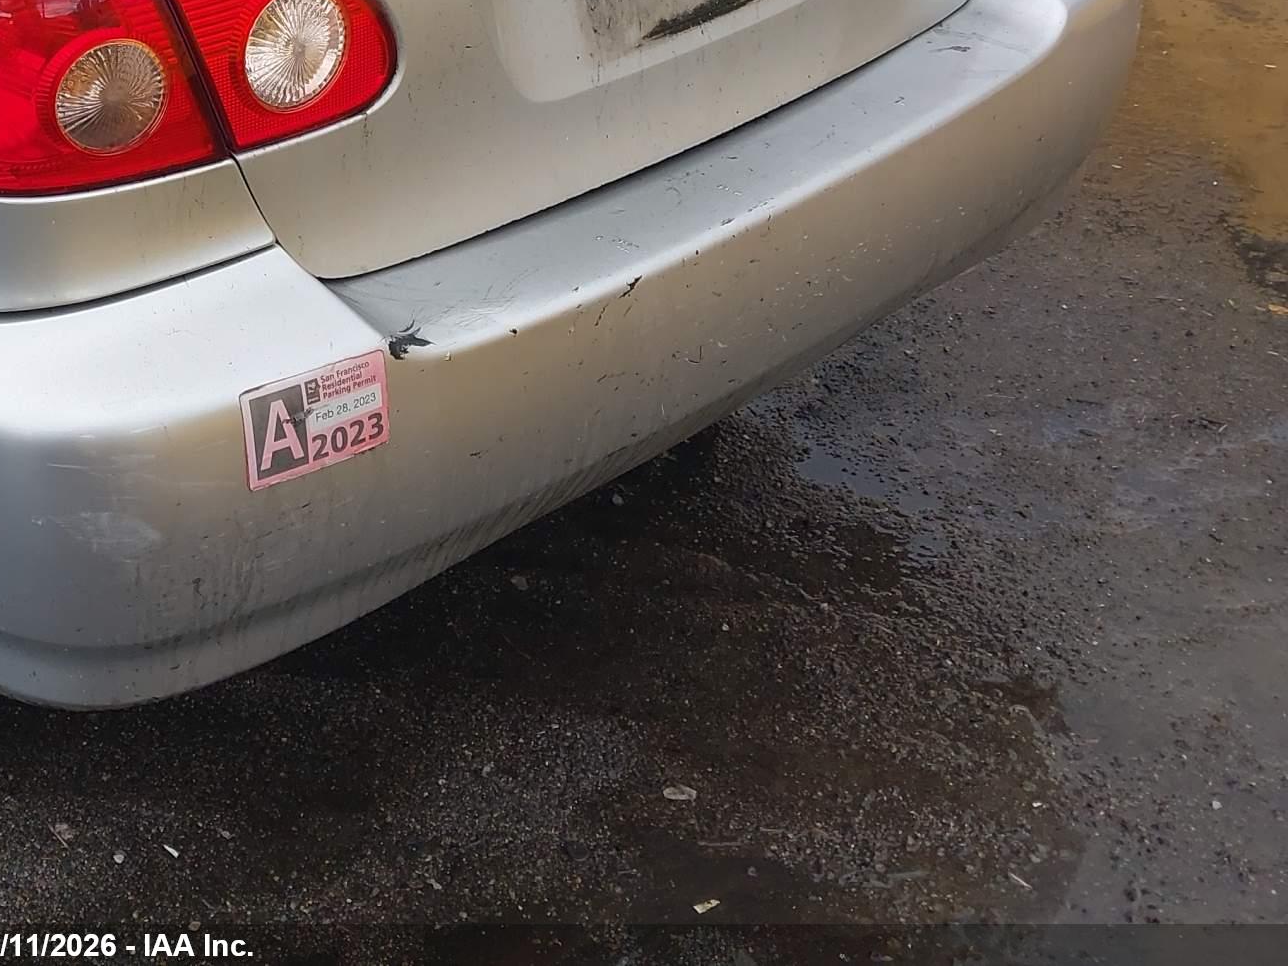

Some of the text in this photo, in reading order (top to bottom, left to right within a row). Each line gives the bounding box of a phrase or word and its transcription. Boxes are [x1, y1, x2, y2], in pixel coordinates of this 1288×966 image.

[320, 361, 370, 384] San Francisco
[321, 371, 363, 391] Residential
[323, 375, 377, 399] Parking Permit
[315, 409, 334, 423] Feb
[353, 392, 377, 409] 2023
[260, 399, 305, 471] A
[311, 412, 385, 461] 2023
